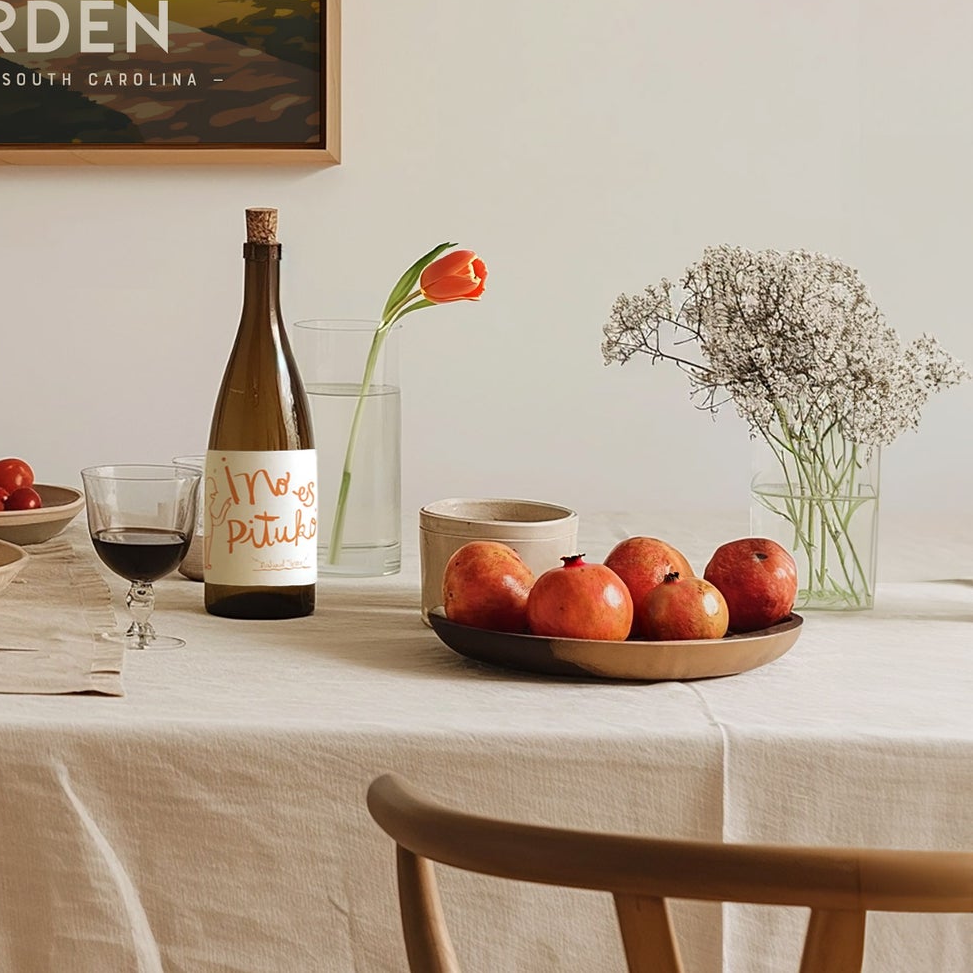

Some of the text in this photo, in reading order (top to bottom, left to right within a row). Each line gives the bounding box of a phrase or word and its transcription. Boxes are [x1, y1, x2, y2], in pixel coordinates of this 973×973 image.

[2, 72, 72, 86] SOUTH
[88, 72, 198, 86] CAROLINA
[291, 481, 315, 508] es
